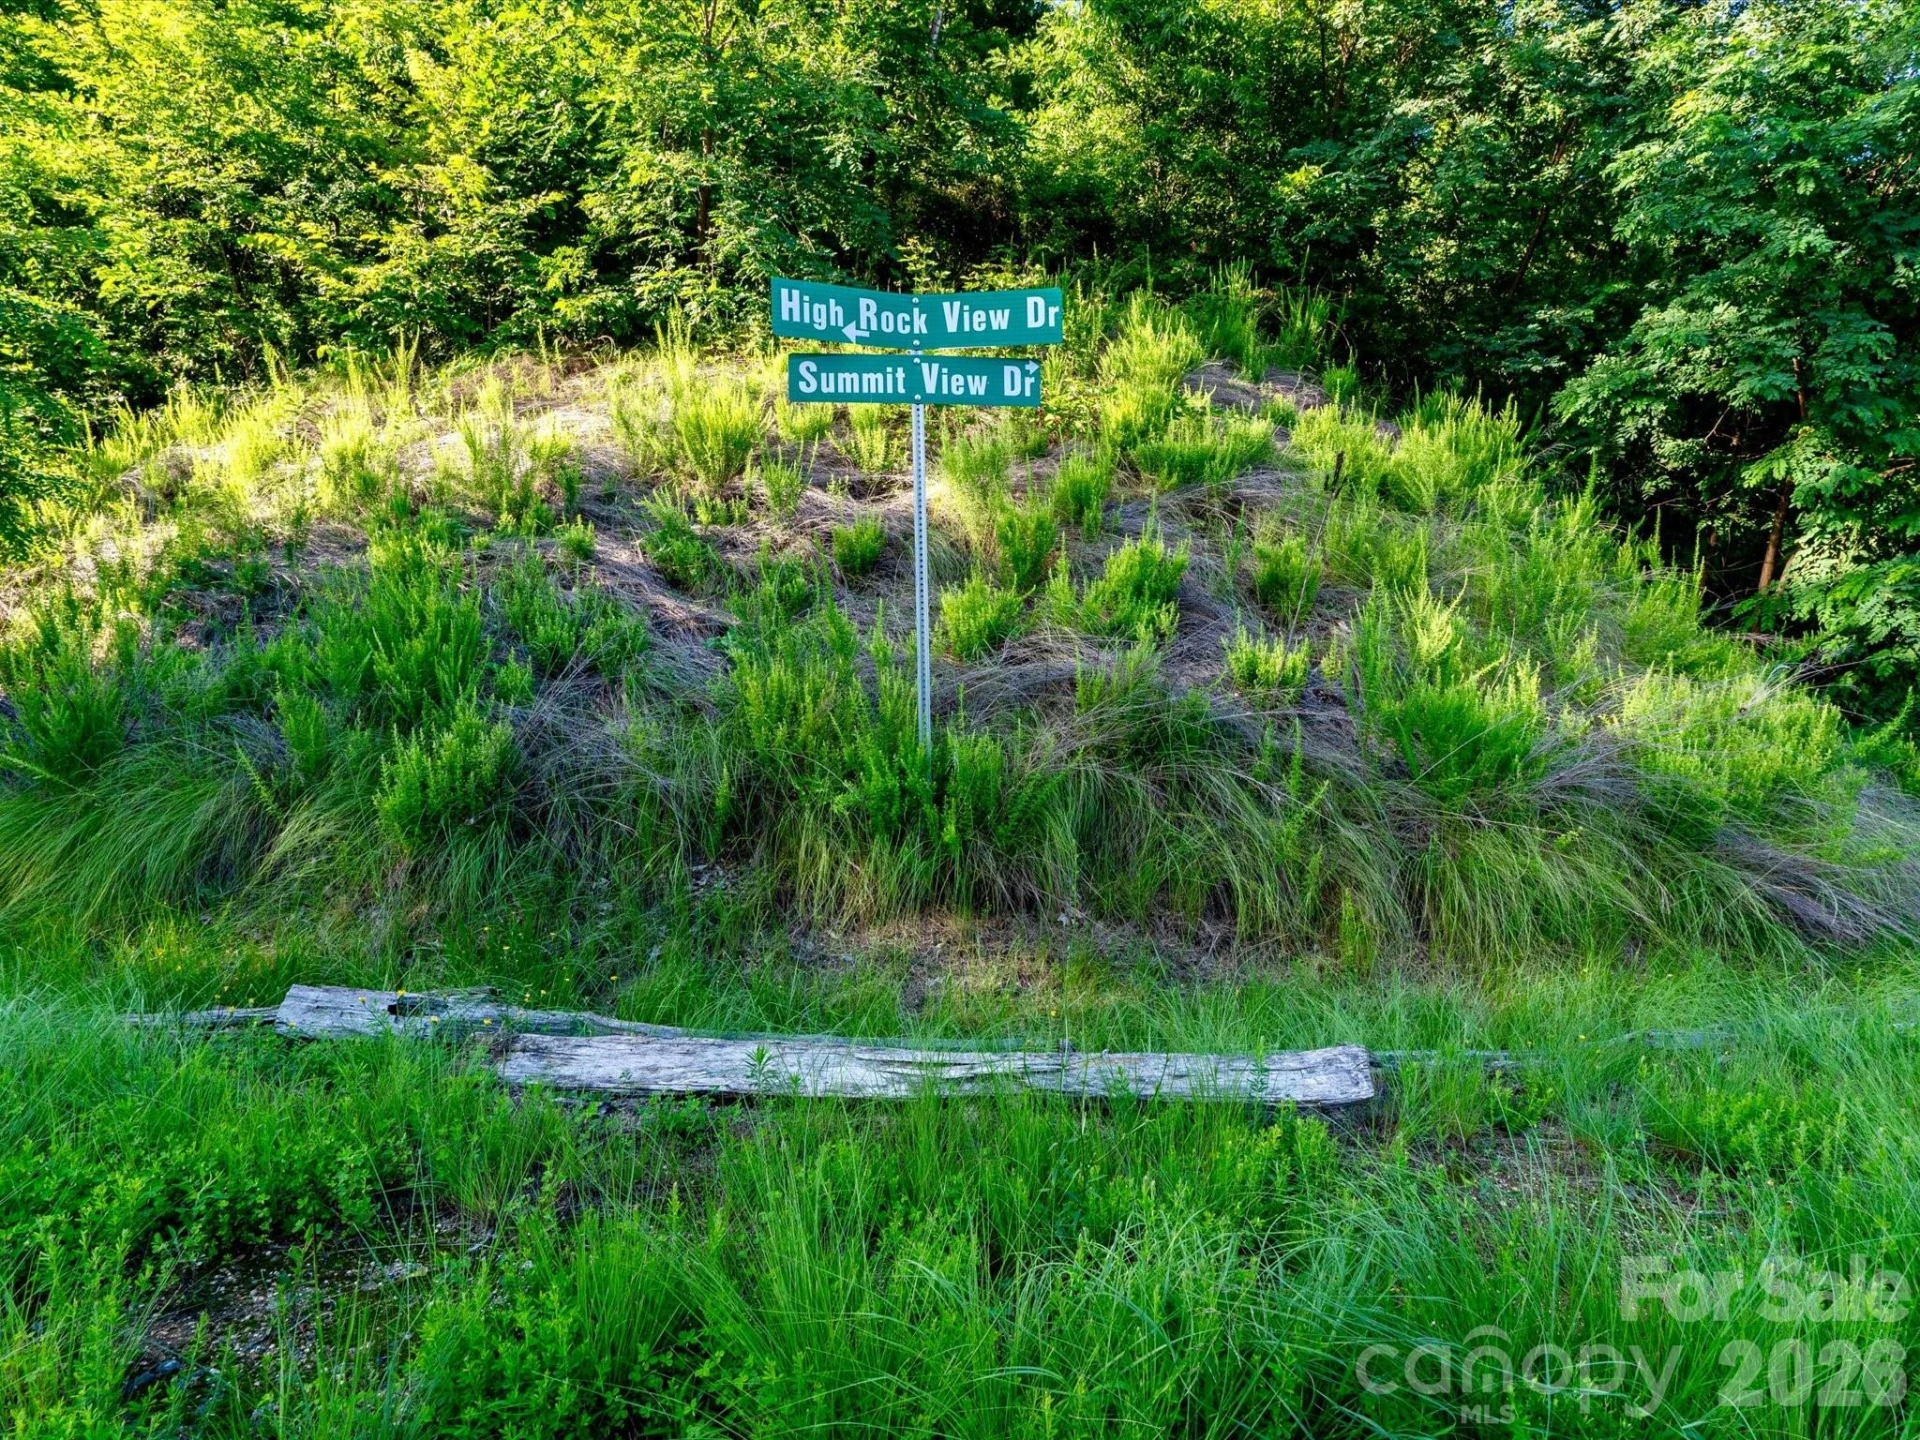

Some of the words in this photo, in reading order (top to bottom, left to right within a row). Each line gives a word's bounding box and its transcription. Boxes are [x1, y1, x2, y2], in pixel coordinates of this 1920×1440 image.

[780, 288, 844, 331] High
[859, 297, 927, 334] Rock
[942, 300, 1010, 333] View
[1026, 296, 1060, 328] Dr
[798, 361, 906, 394] Summit
[921, 363, 988, 396] View
[1003, 365, 1035, 397] Dr
